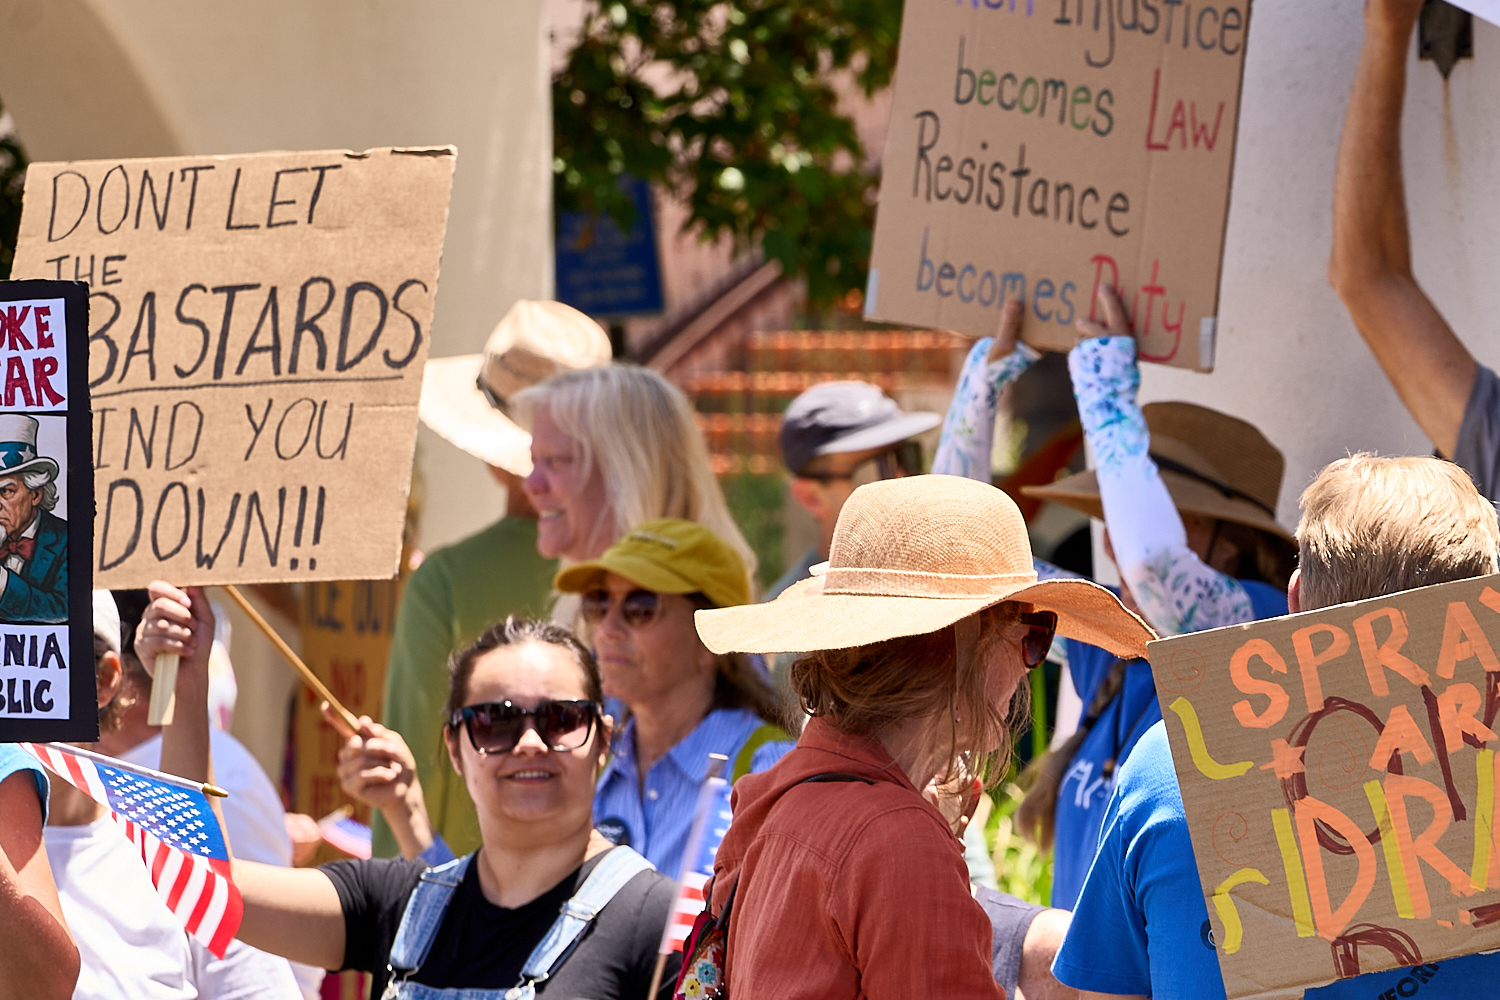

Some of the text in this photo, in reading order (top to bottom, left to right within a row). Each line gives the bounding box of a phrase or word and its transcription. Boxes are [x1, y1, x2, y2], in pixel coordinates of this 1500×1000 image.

[954, 34, 1224, 152] becomes LAW
[47, 164, 342, 242] DONT LET
[913, 110, 1130, 237] Resistance
[46, 254, 127, 285] THE
[916, 225, 1075, 327] becomes
[89, 276, 428, 388] BASTARDS
[0, 356, 66, 407] AR
[243, 397, 353, 461] YOU
[99, 479, 326, 571] DOWN!!
[0, 632, 66, 669] NIA
